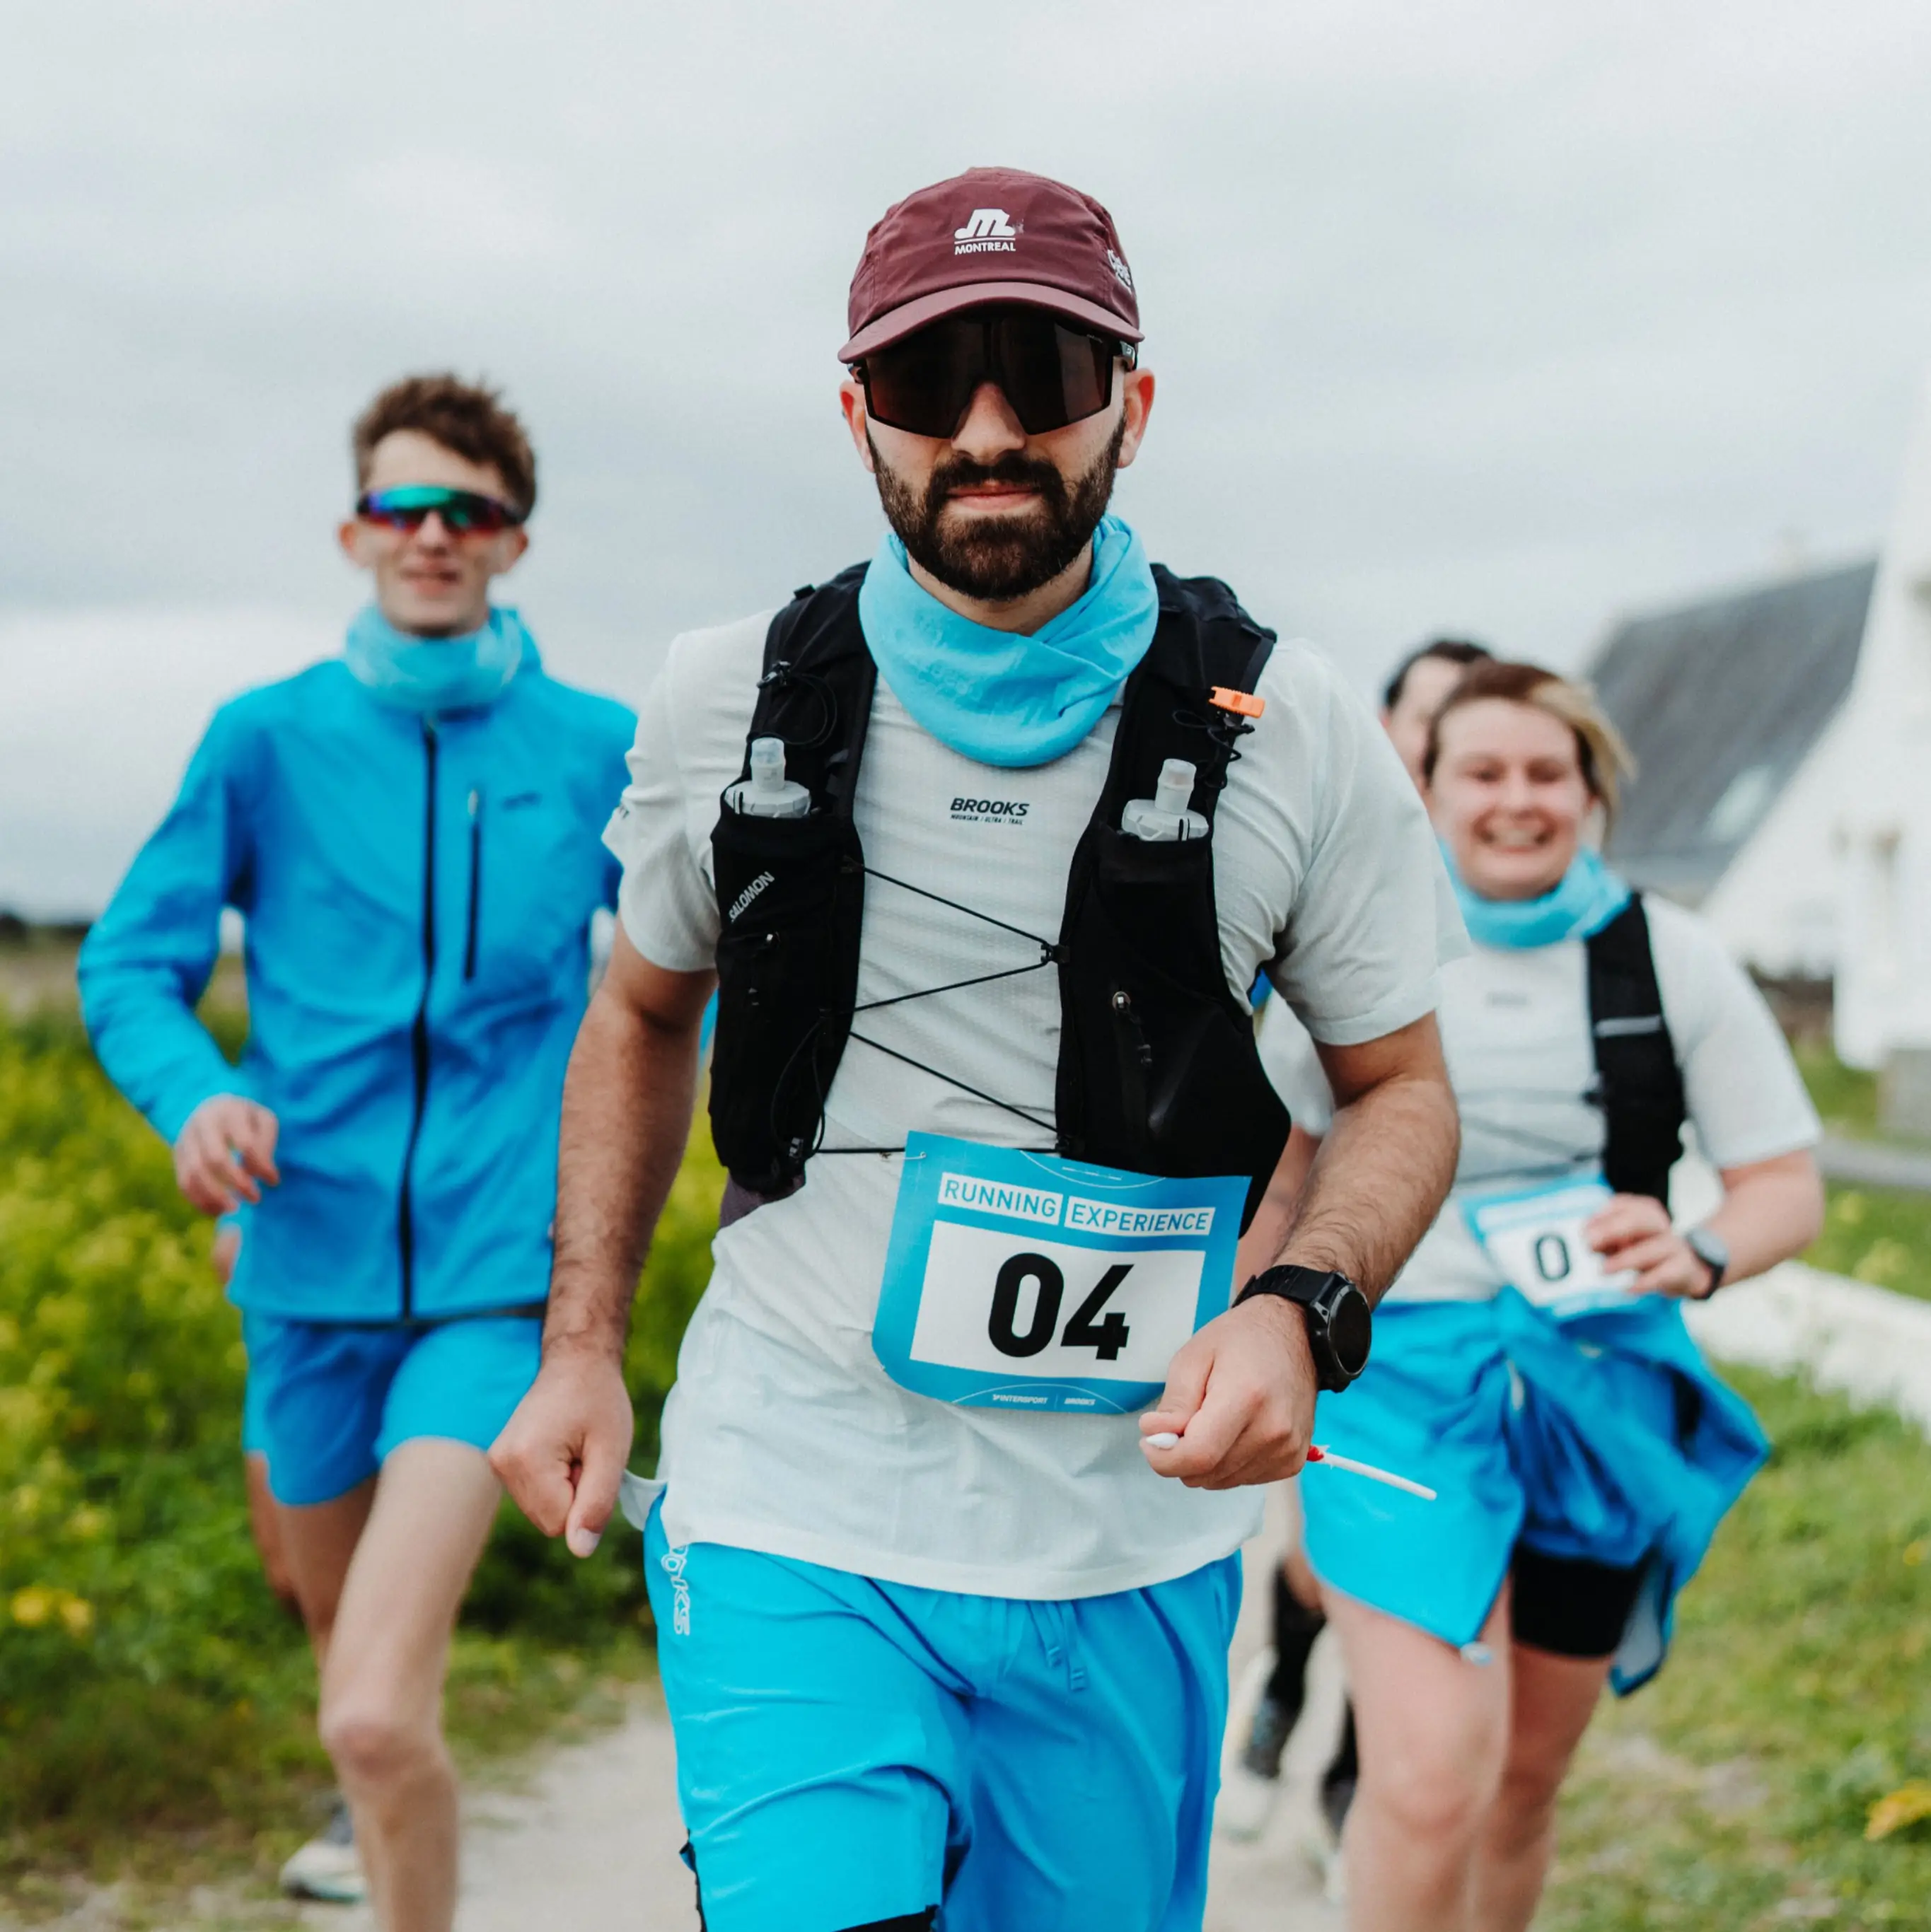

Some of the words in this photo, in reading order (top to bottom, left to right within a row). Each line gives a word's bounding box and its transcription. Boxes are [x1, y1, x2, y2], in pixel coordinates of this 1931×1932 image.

[954, 242, 1016, 255] MONTREAL
[950, 798, 1030, 816] BROOKS
[729, 871, 775, 924] SALOMON
[944, 1180, 1057, 1217] RUNNING
[1071, 1204, 1210, 1232] EXPERIENCE
[1536, 1233, 1570, 1281] 0
[987, 1252, 1135, 1361] 04
